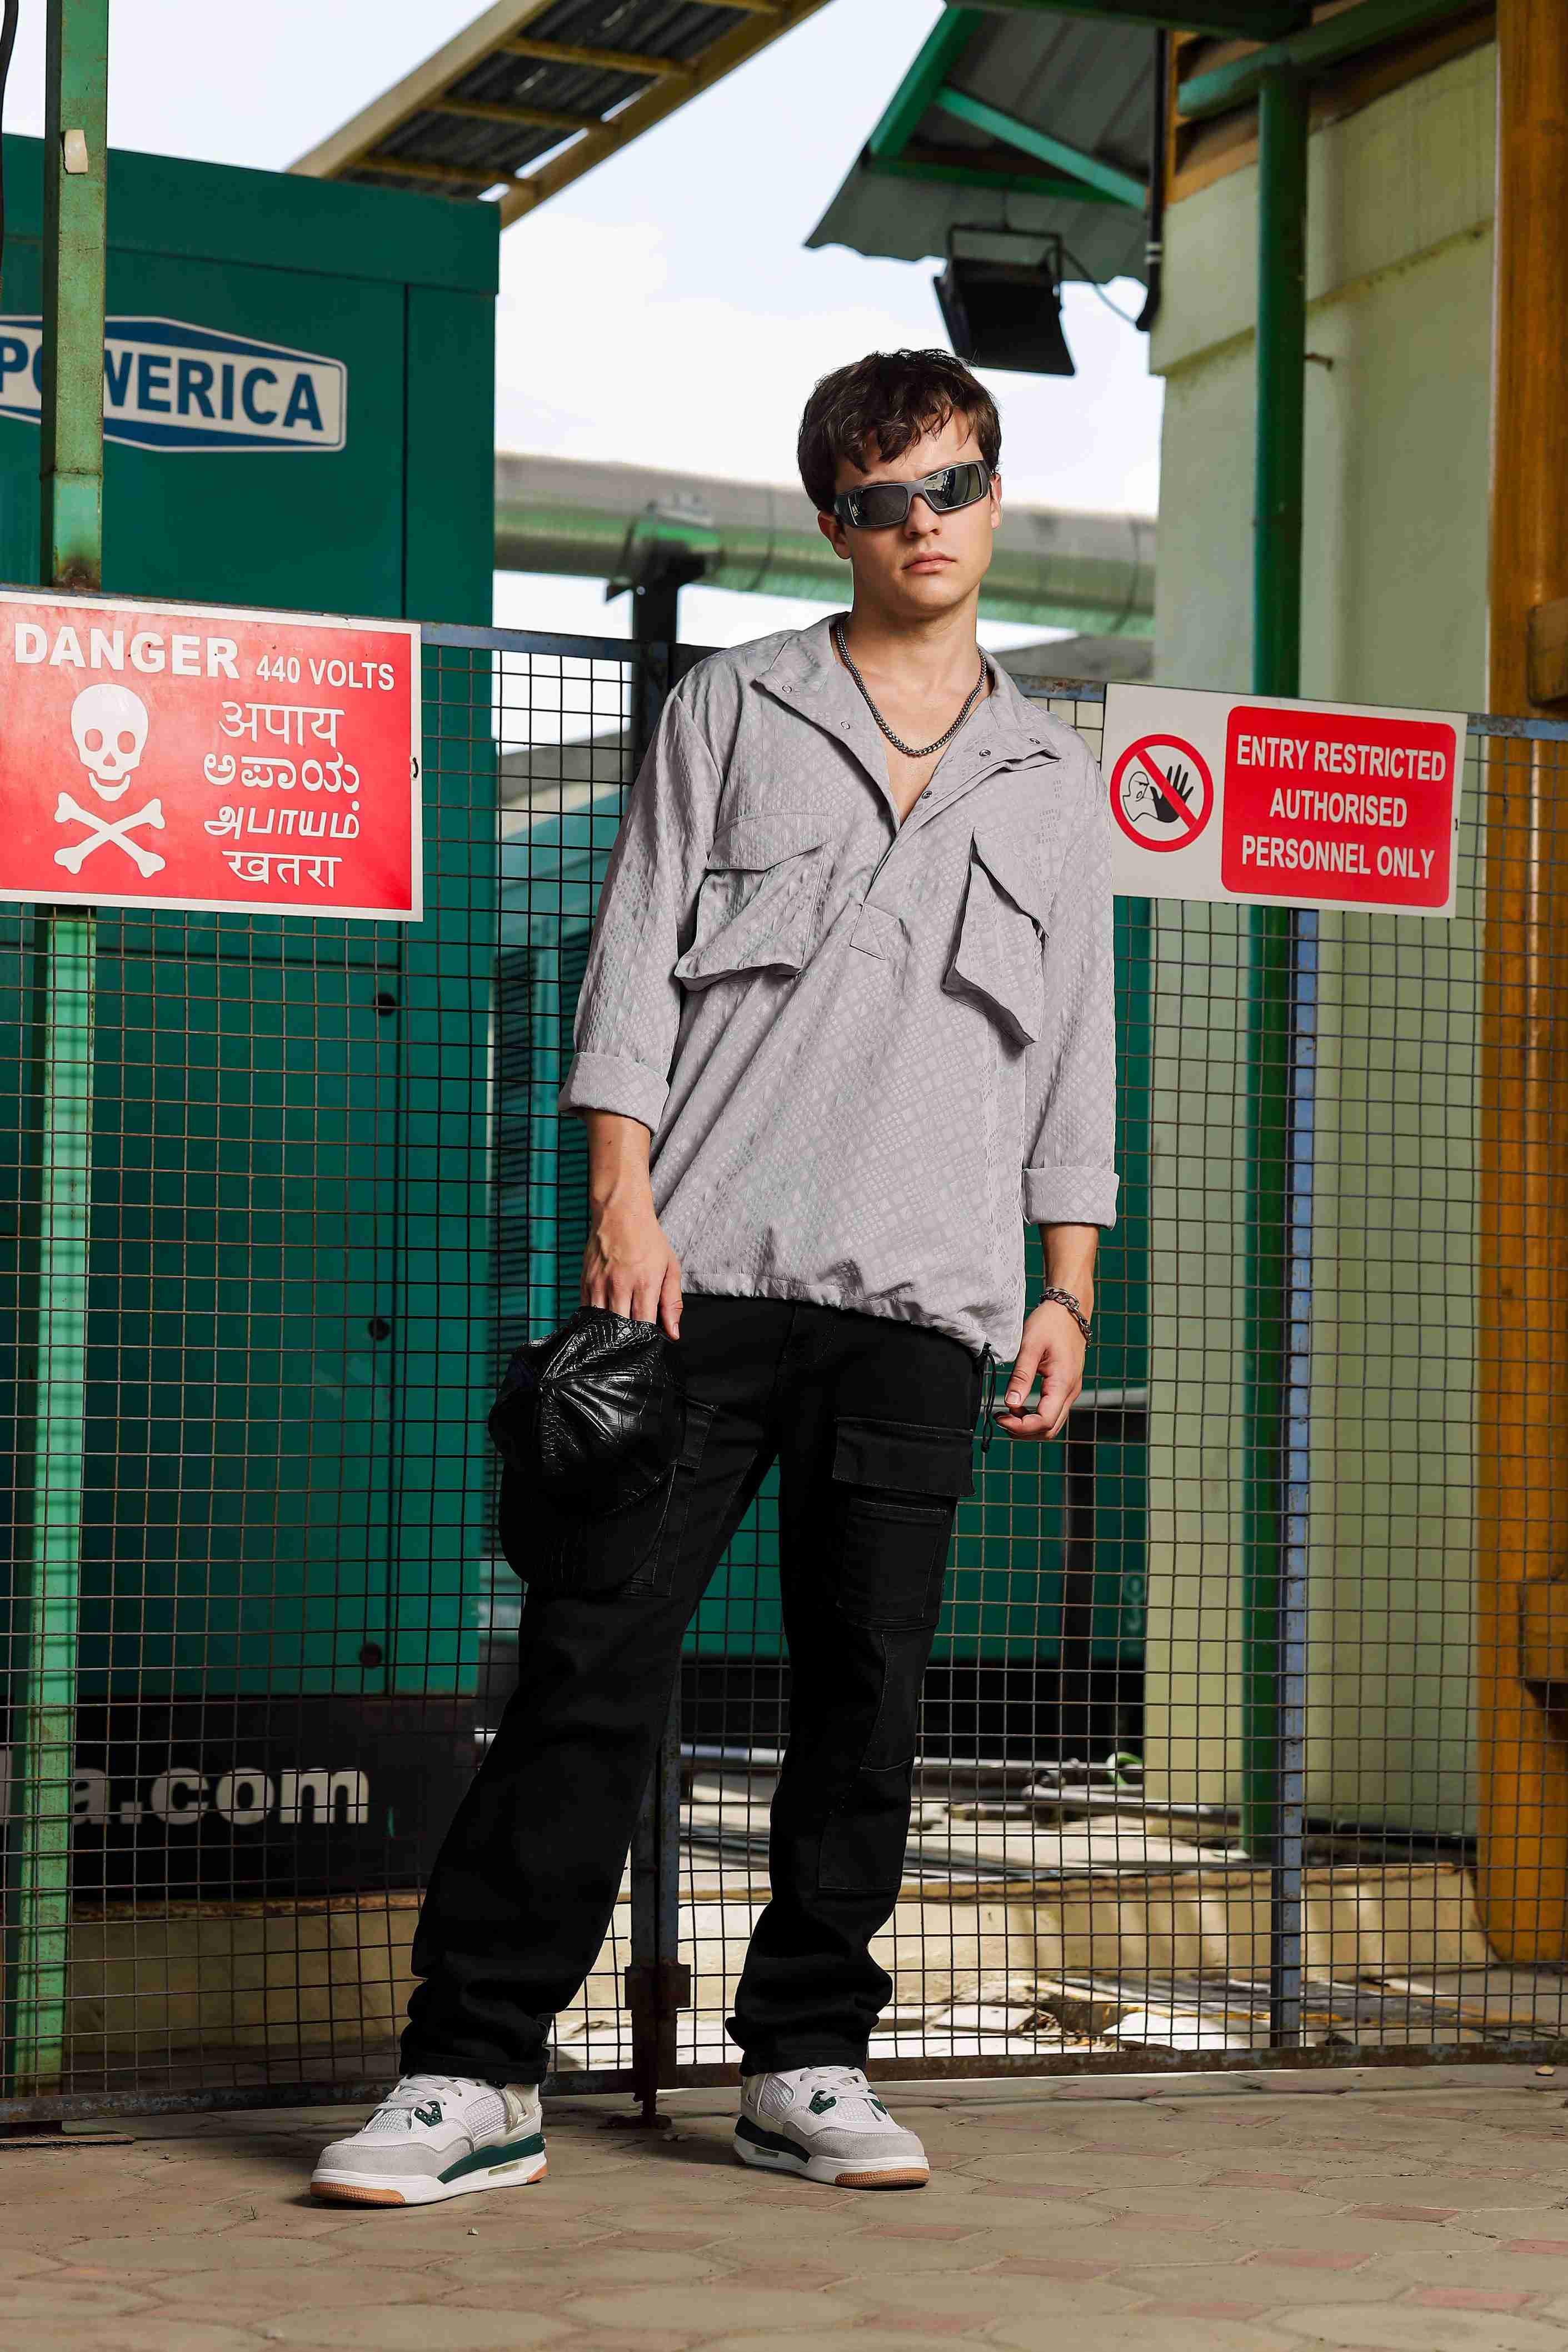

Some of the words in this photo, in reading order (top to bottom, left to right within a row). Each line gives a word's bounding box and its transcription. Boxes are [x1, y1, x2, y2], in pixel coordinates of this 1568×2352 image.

[0, 336, 324, 432] PWERICA
[14, 623, 240, 680] DANGER
[256, 656, 301, 684] 440
[309, 658, 395, 691] VOLTS
[218, 701, 346, 748] अपाय
[203, 752, 360, 794] ಅಪಾಯ
[1237, 735, 1310, 771] ENTRY
[1314, 742, 1446, 781] RESTRICTED
[203, 800, 360, 840] அபாயம்
[1269, 788, 1407, 827] AUTHORISED
[222, 851, 343, 888] खतरा
[1242, 835, 1371, 875] PERSONNEL
[1377, 846, 1435, 879] ONLY
[0, 1750, 369, 1826] a.com
